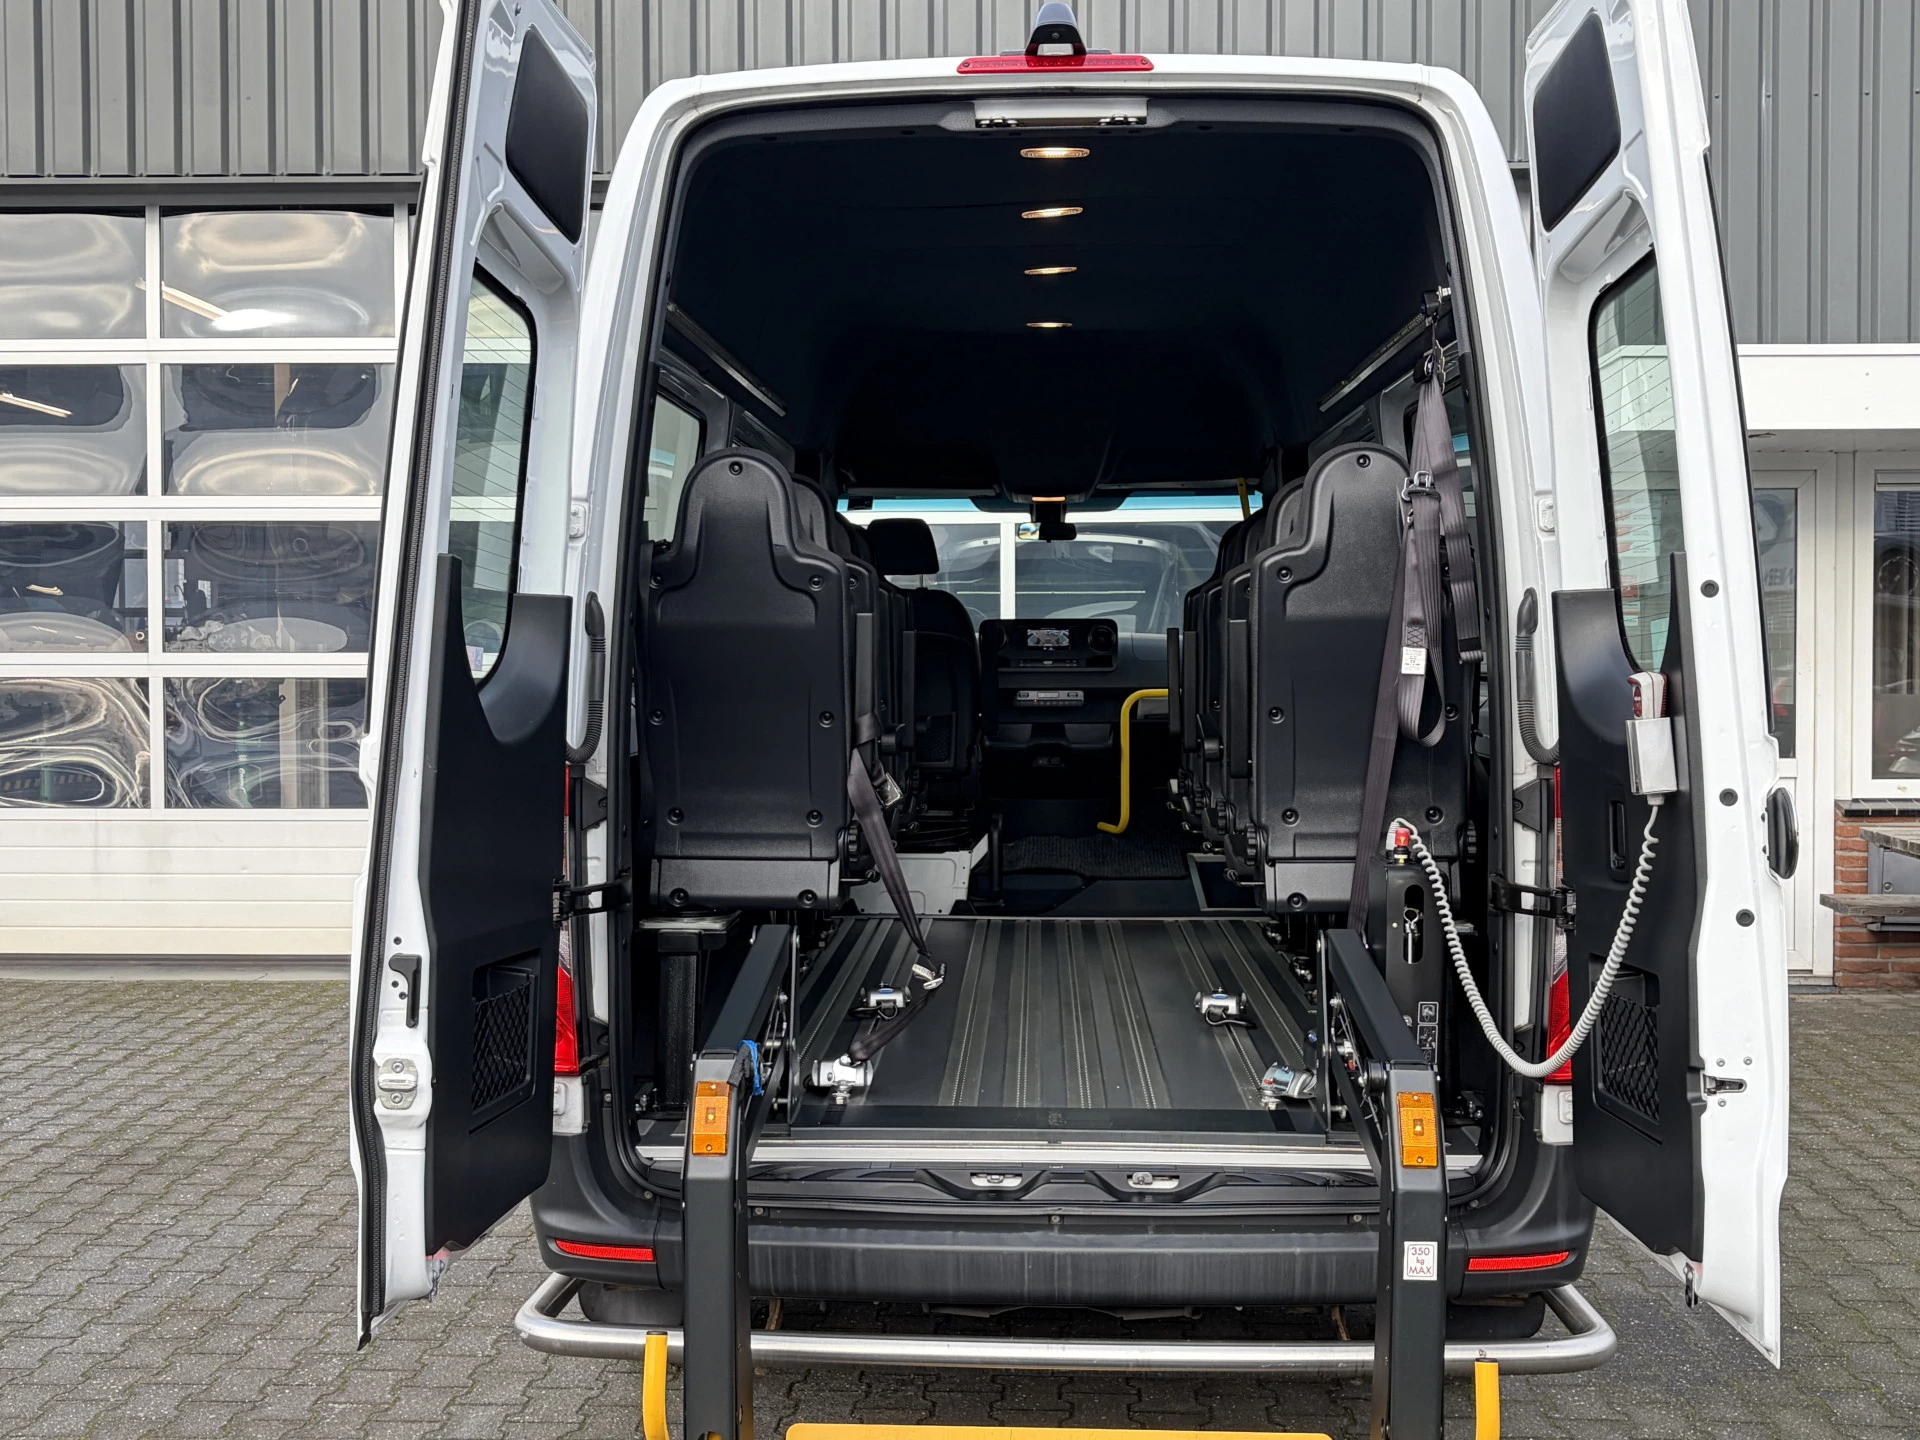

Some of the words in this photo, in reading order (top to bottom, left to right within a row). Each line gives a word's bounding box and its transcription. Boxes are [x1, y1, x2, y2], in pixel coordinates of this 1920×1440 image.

[1411, 1247, 1430, 1256] 350
[1416, 1256, 1425, 1265] kg
[1409, 1266, 1431, 1274] MAX
